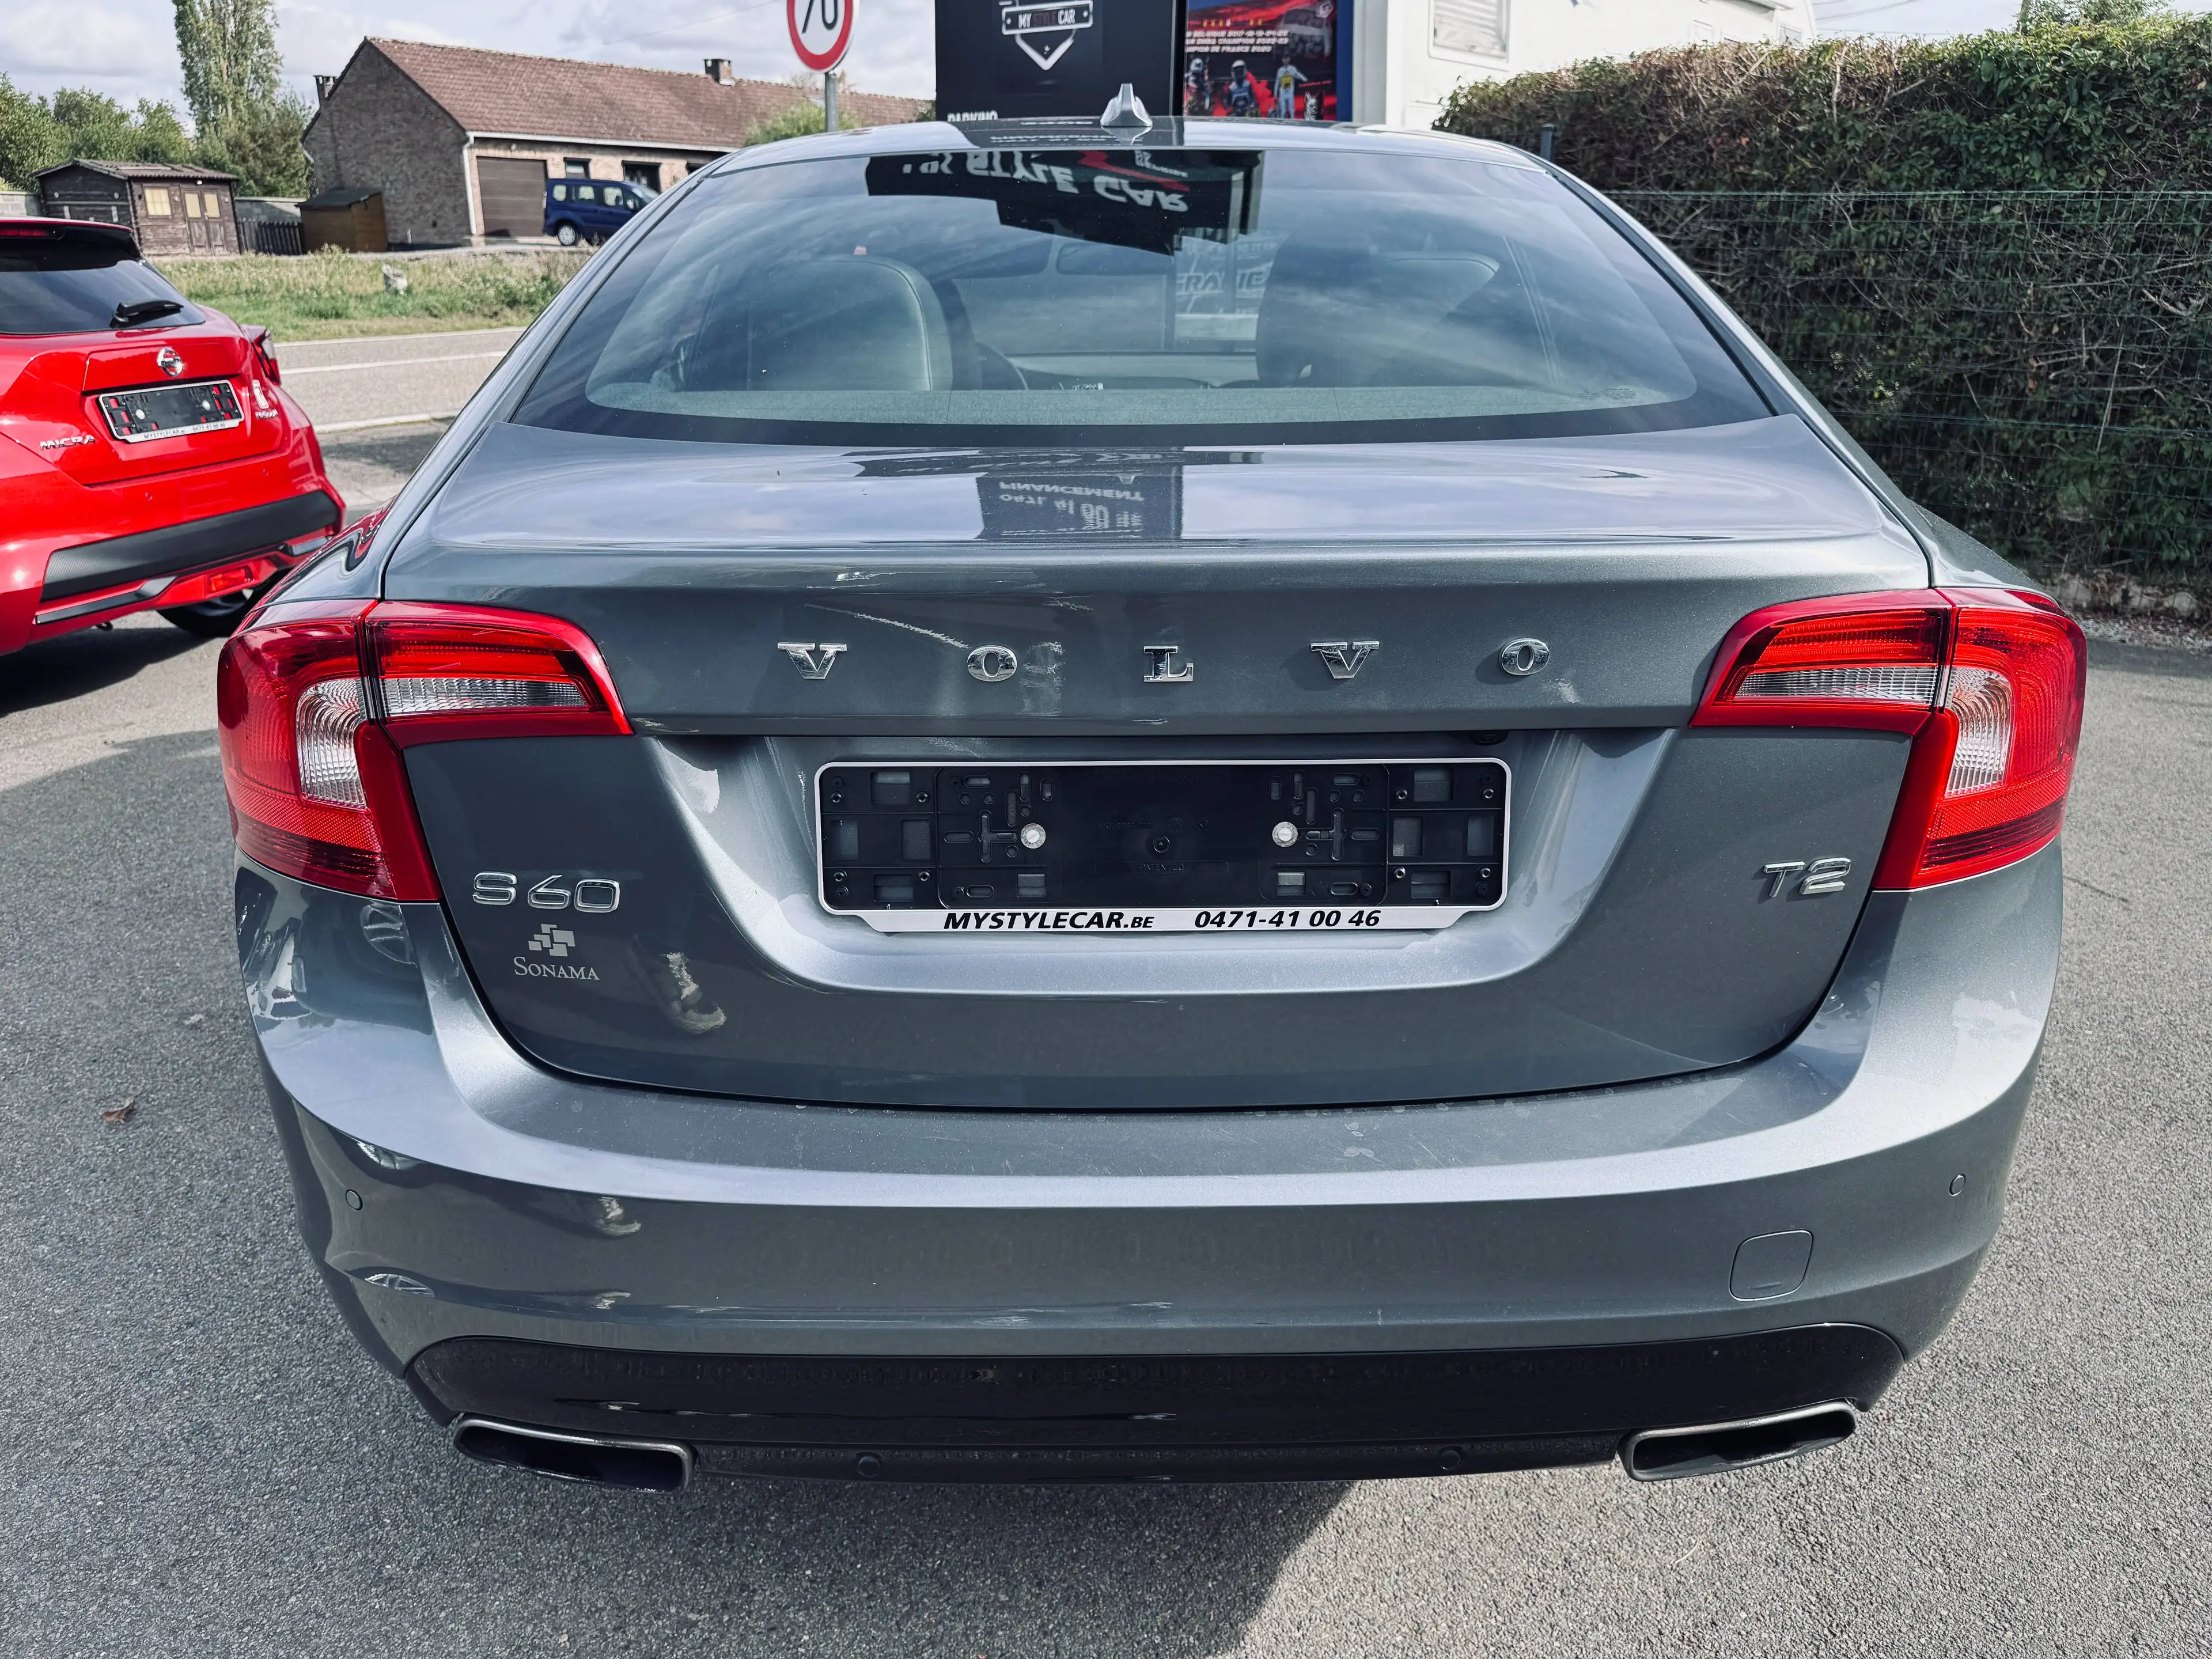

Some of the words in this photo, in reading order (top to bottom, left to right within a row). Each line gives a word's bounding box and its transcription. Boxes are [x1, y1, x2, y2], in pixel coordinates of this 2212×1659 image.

[1018, 13, 1032, 29] MY
[1032, 10, 1057, 26] STYLE
[1058, 9, 1075, 25] CAR
[40, 434, 96, 450] MICRA
[777, 638, 1551, 681] VOLVO
[1139, 863, 1184, 872] PATENTED
[1763, 857, 1851, 898] T2
[472, 871, 620, 914] S60
[943, 912, 1155, 930] MYSTYLECAR.BE
[1194, 910, 1298, 928] 0471-41
[1309, 910, 1340, 927] 00
[1348, 909, 1381, 927] 46
